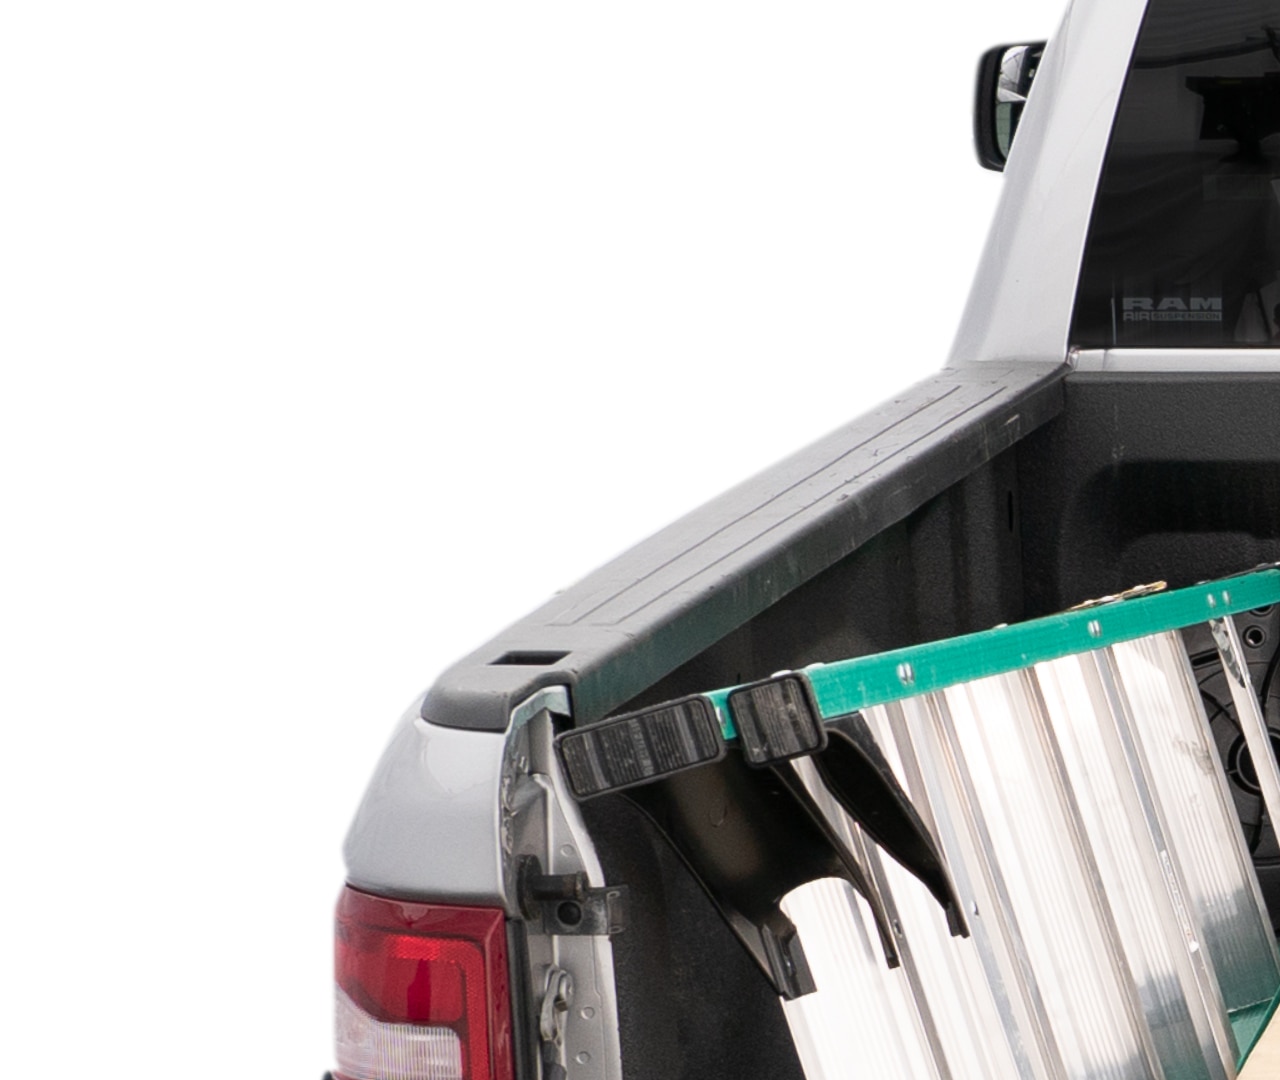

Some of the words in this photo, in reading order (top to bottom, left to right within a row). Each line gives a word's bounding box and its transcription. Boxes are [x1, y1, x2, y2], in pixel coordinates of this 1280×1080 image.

[1122, 297, 1222, 310] RAM
[1123, 312, 1150, 321] AIR
[1152, 312, 1221, 321] SUSPENSION
